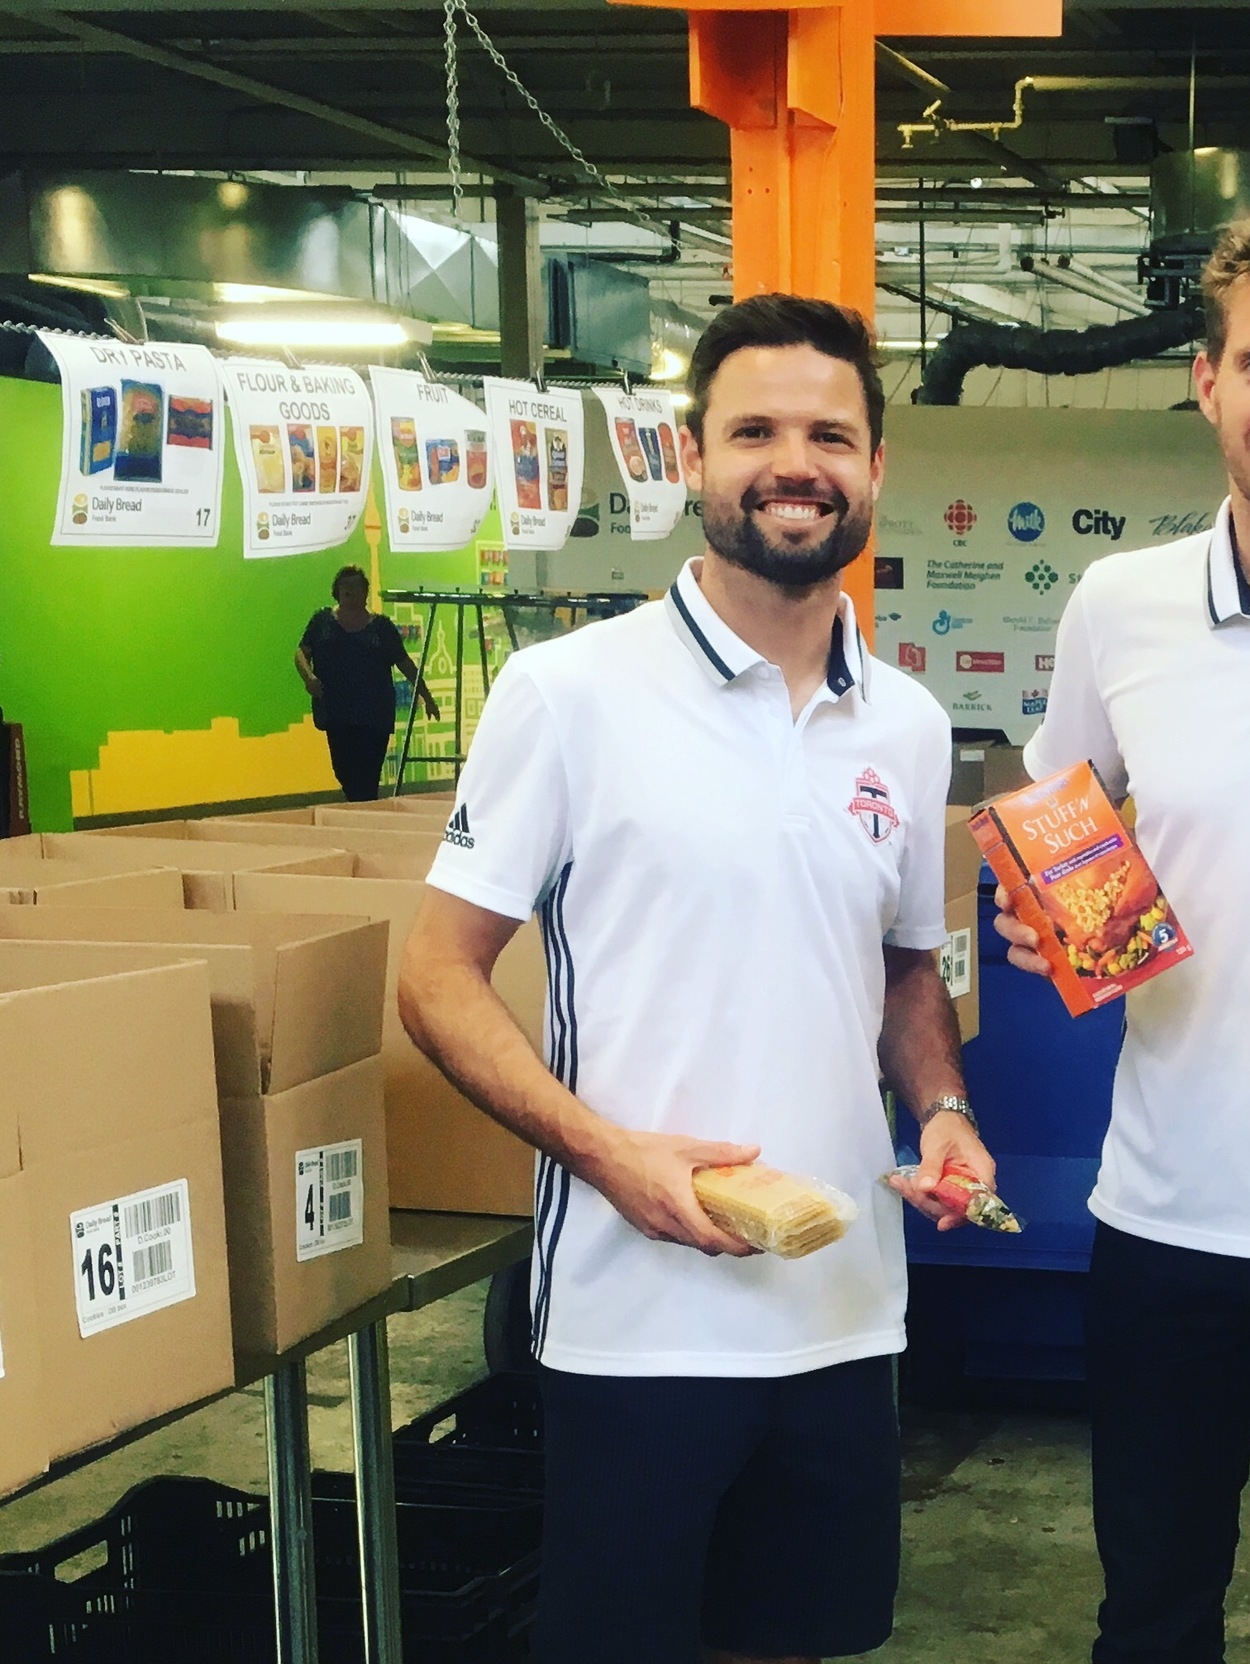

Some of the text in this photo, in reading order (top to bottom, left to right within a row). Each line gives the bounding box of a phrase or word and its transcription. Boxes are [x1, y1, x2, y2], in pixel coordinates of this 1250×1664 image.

[90, 346, 187, 372] DRY PASTA
[237, 372, 356, 395] FLOUR & BAKING
[416, 383, 449, 404] FRUIT
[279, 401, 331, 421] GOODS
[508, 399, 567, 422] HOT CEREAL
[618, 395, 663, 414] HOT DRINKS
[92, 497, 142, 512] Daily Bread
[195, 508, 211, 527] 17
[272, 513, 311, 528] Daily Bread
[411, 511, 443, 525] Daily Bread
[1072, 508, 1126, 541] City
[926, 570, 963, 579] Maxwell
[927, 560, 1004, 570] The Catherine and
[926, 581, 976, 590] Foundation
[855, 799, 894, 815] TORONTO
[1044, 816, 1099, 854] SUCH
[1158, 928, 1169, 943] 5
[304, 1183, 315, 1231] 4
[81, 1243, 115, 1301] 16
